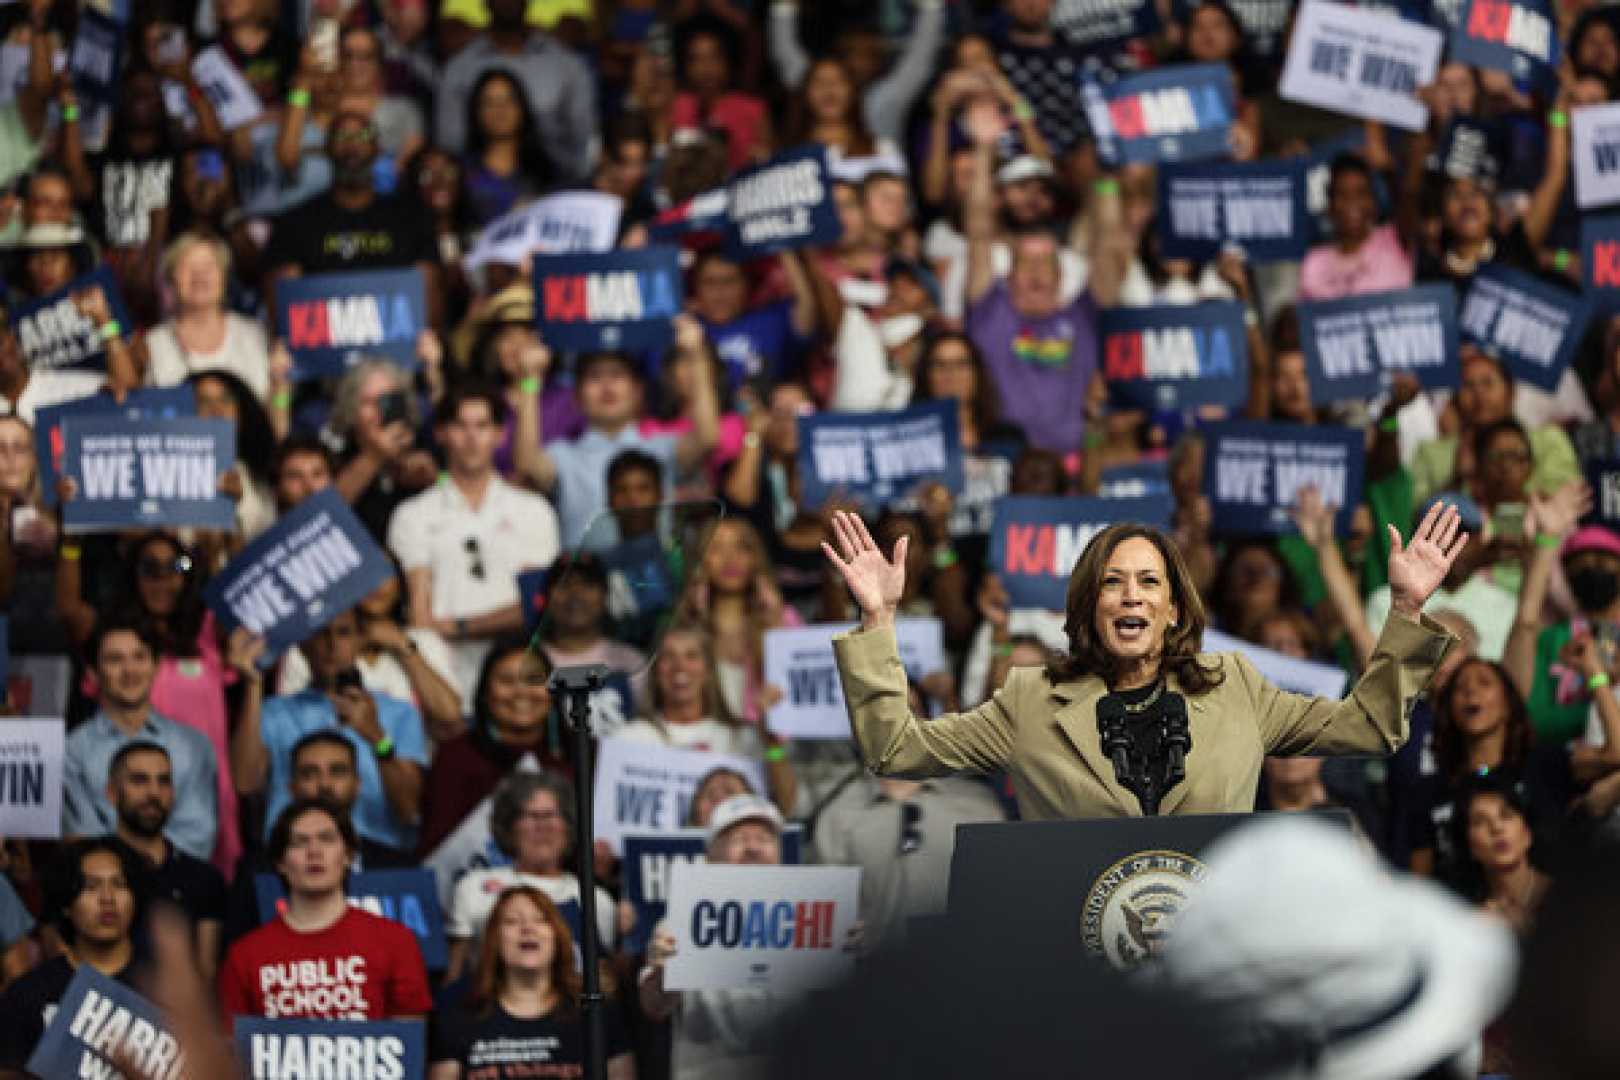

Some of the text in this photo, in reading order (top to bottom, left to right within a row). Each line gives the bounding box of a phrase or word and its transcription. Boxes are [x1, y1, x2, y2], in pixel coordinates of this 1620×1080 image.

[1310, 40, 1351, 82] WE
[1108, 83, 1231, 140] KAMALA
[1172, 197, 1294, 238] WE WIN
[542, 269, 679, 323] KAMALA
[288, 292, 416, 349] KAMALA
[1105, 318, 1235, 380] KAMALA
[1316, 321, 1446, 379] WE WIN
[82, 453, 216, 500] WE WIN
[812, 433, 946, 483] WE WIN
[1216, 457, 1266, 504] WE
[232, 525, 362, 633] WE WIN
[788, 667, 839, 706] WE
[0, 761, 45, 806] IN
[613, 781, 665, 829] WE
[691, 898, 836, 949] COACH!
[259, 955, 367, 993] PUBLIC
[264, 984, 369, 1019] SCHOOL
[252, 1033, 406, 1080] HARRIS
